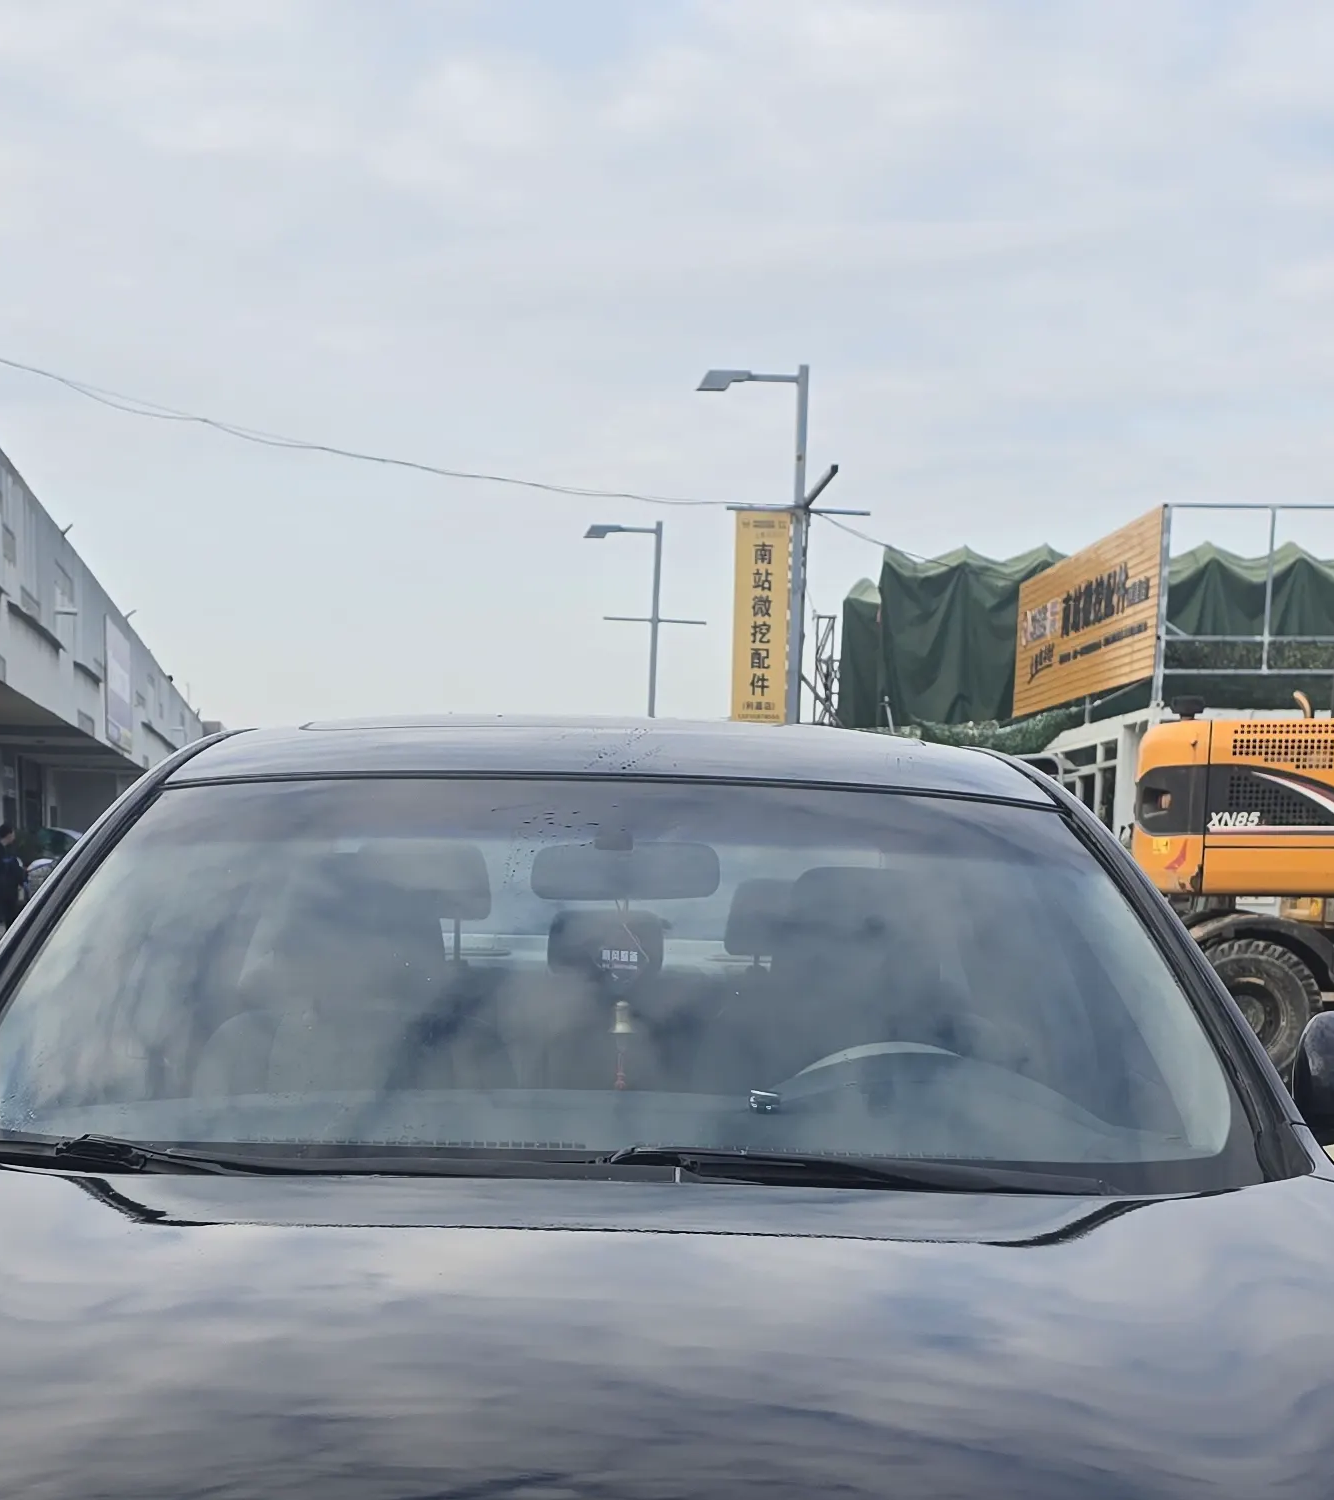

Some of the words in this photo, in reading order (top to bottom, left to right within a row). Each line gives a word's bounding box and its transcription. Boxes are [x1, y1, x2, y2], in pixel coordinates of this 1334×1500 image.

[748, 541, 774, 697] 南站微挖配件
[1207, 812, 1260, 827] XN85
